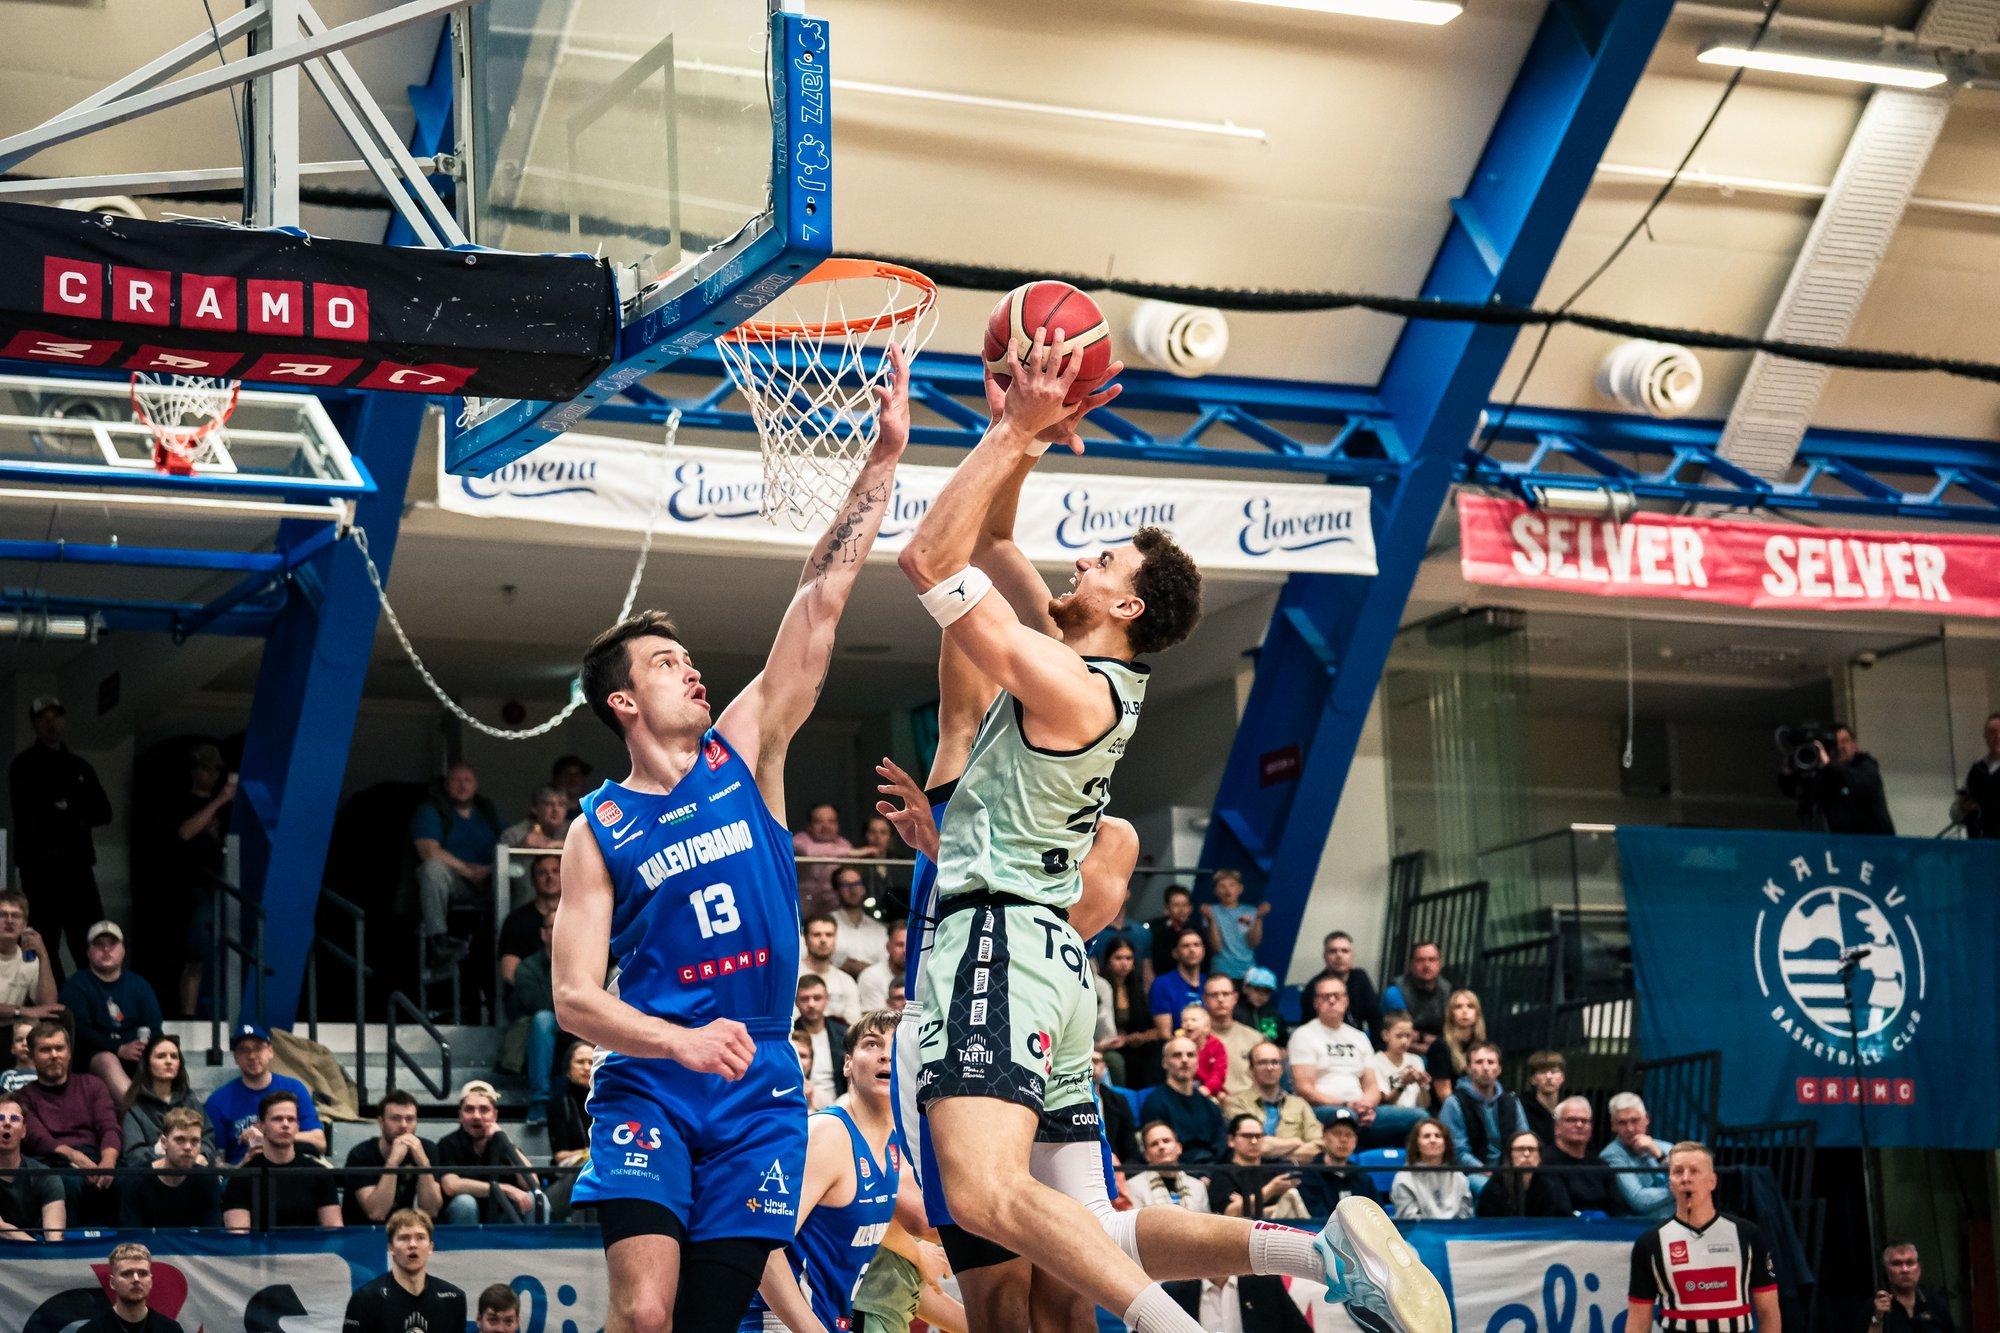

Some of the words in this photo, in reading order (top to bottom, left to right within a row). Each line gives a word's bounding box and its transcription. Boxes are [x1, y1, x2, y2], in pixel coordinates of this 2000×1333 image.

[57, 269, 356, 330] CRAMO
[1056, 487, 1176, 549] Elovena
[1238, 495, 1355, 556] Elovena
[1510, 512, 1707, 587] SELVER
[1762, 535, 1952, 602] SELVER
[709, 781, 742, 802] LIGNATOR
[601, 809, 620, 822] KING
[658, 803, 698, 824] UNIBET
[637, 819, 754, 891] KALEV/CRAMO
[1762, 850, 1906, 904] KALEV
[689, 882, 742, 940] 13
[981, 939, 990, 960] BALLZY
[682, 951, 766, 981] CRAMO
[977, 970, 986, 991] BALLZY
[973, 1001, 984, 1023] BALLZY
[1892, 1009, 1922, 1052] CLUB
[957, 1048, 994, 1065] TARTU
[1801, 1081, 1911, 1100] CRAMO
[764, 1199, 787, 1208] Linus
[764, 1207, 795, 1216] Medical
[1697, 1281, 1728, 1291] Optibet
